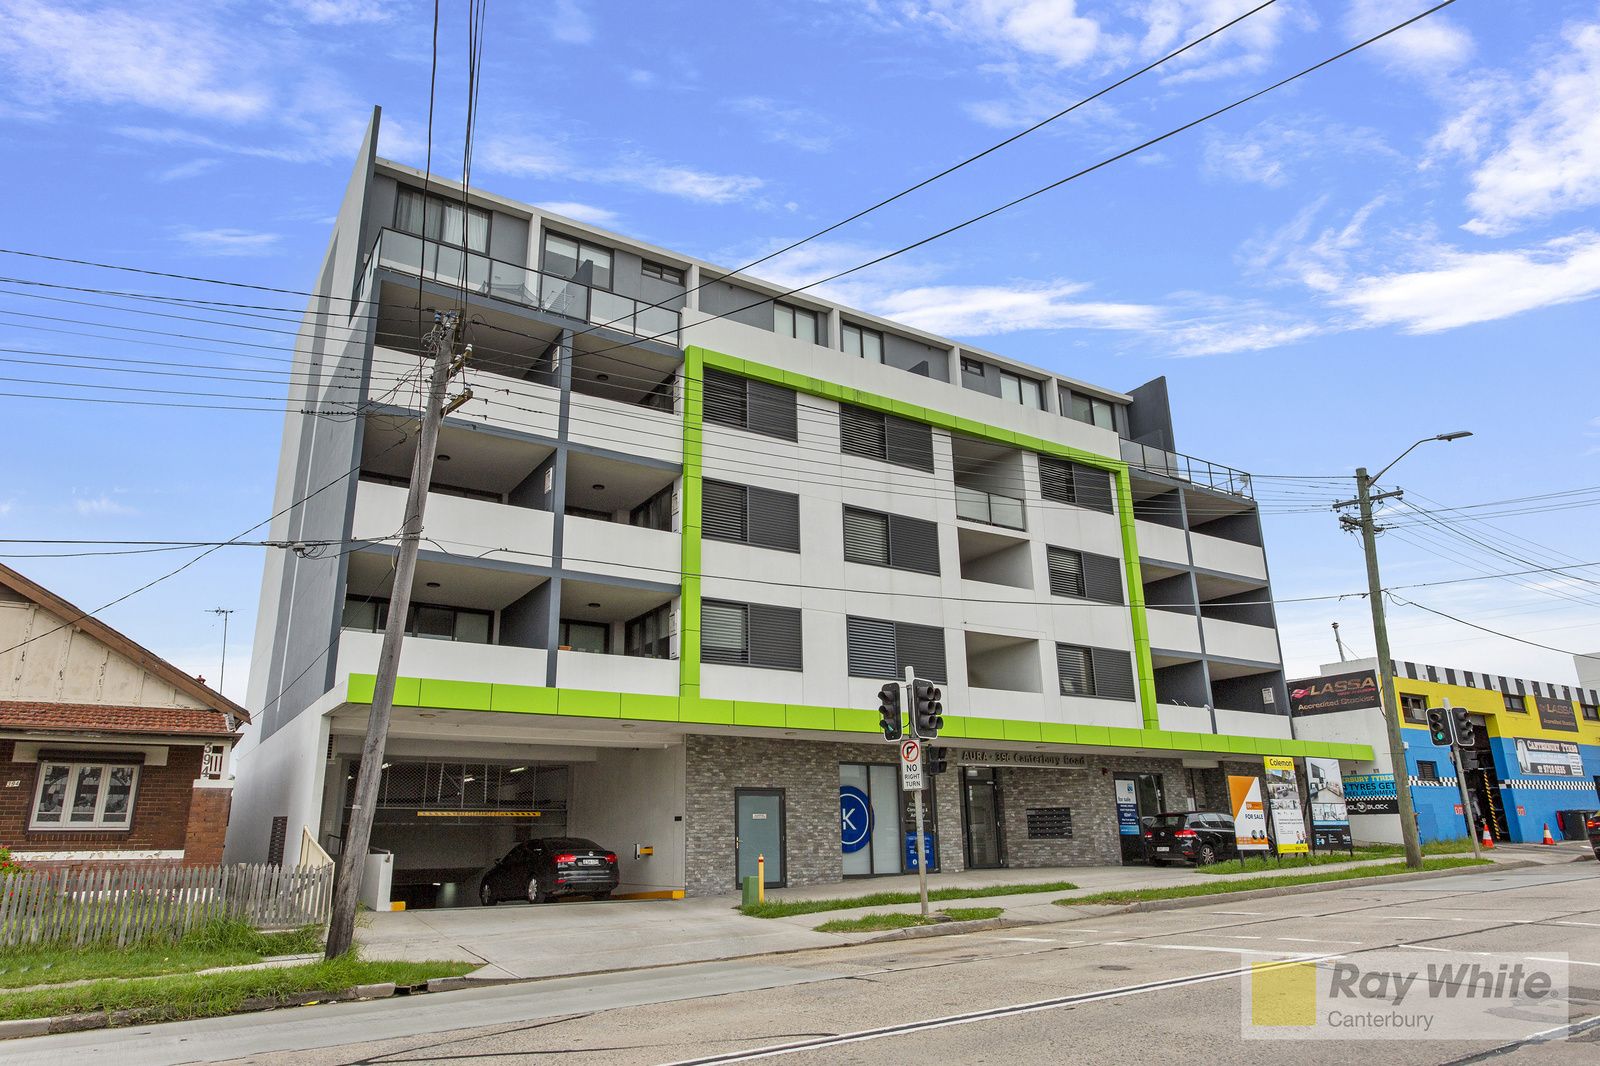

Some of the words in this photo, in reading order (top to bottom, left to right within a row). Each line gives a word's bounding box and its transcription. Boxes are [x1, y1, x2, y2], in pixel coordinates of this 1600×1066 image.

[1310, 677, 1375, 695] LASSA
[201, 742, 213, 778] 394
[961, 750, 988, 761] AURA
[1012, 753, 1060, 766] Canterbury
[906, 764, 918, 773] NO
[904, 773, 921, 781] RIGHT
[905, 781, 921, 789] TURN
[1349, 782, 1377, 791] TYRES
[1378, 781, 1397, 790] GET
[842, 808, 857, 830] K
